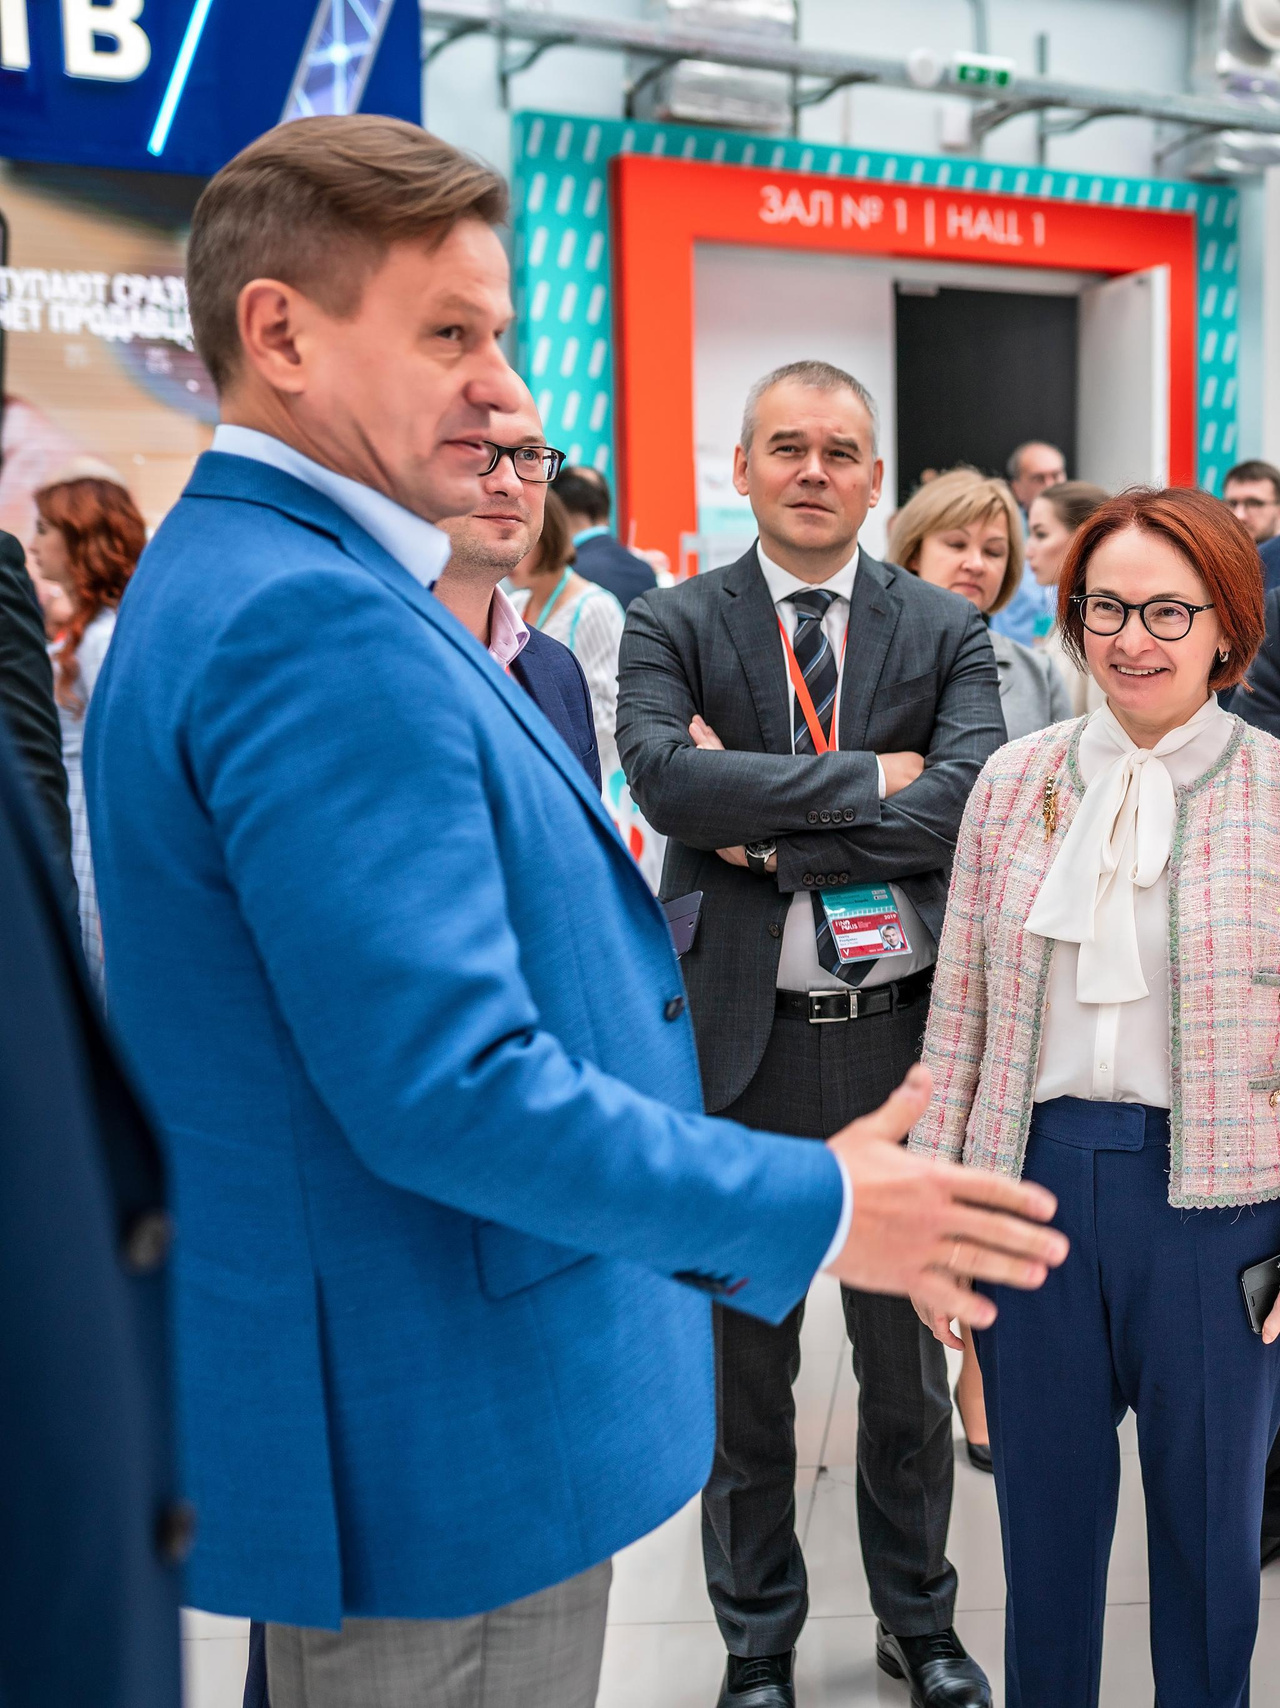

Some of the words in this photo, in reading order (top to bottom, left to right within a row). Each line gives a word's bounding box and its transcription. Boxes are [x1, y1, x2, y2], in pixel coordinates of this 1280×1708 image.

[759, 185, 834, 228] ЗАЛ
[893, 197, 908, 235] 1
[947, 204, 1023, 246] HALL
[1031, 211, 1045, 247] 1
